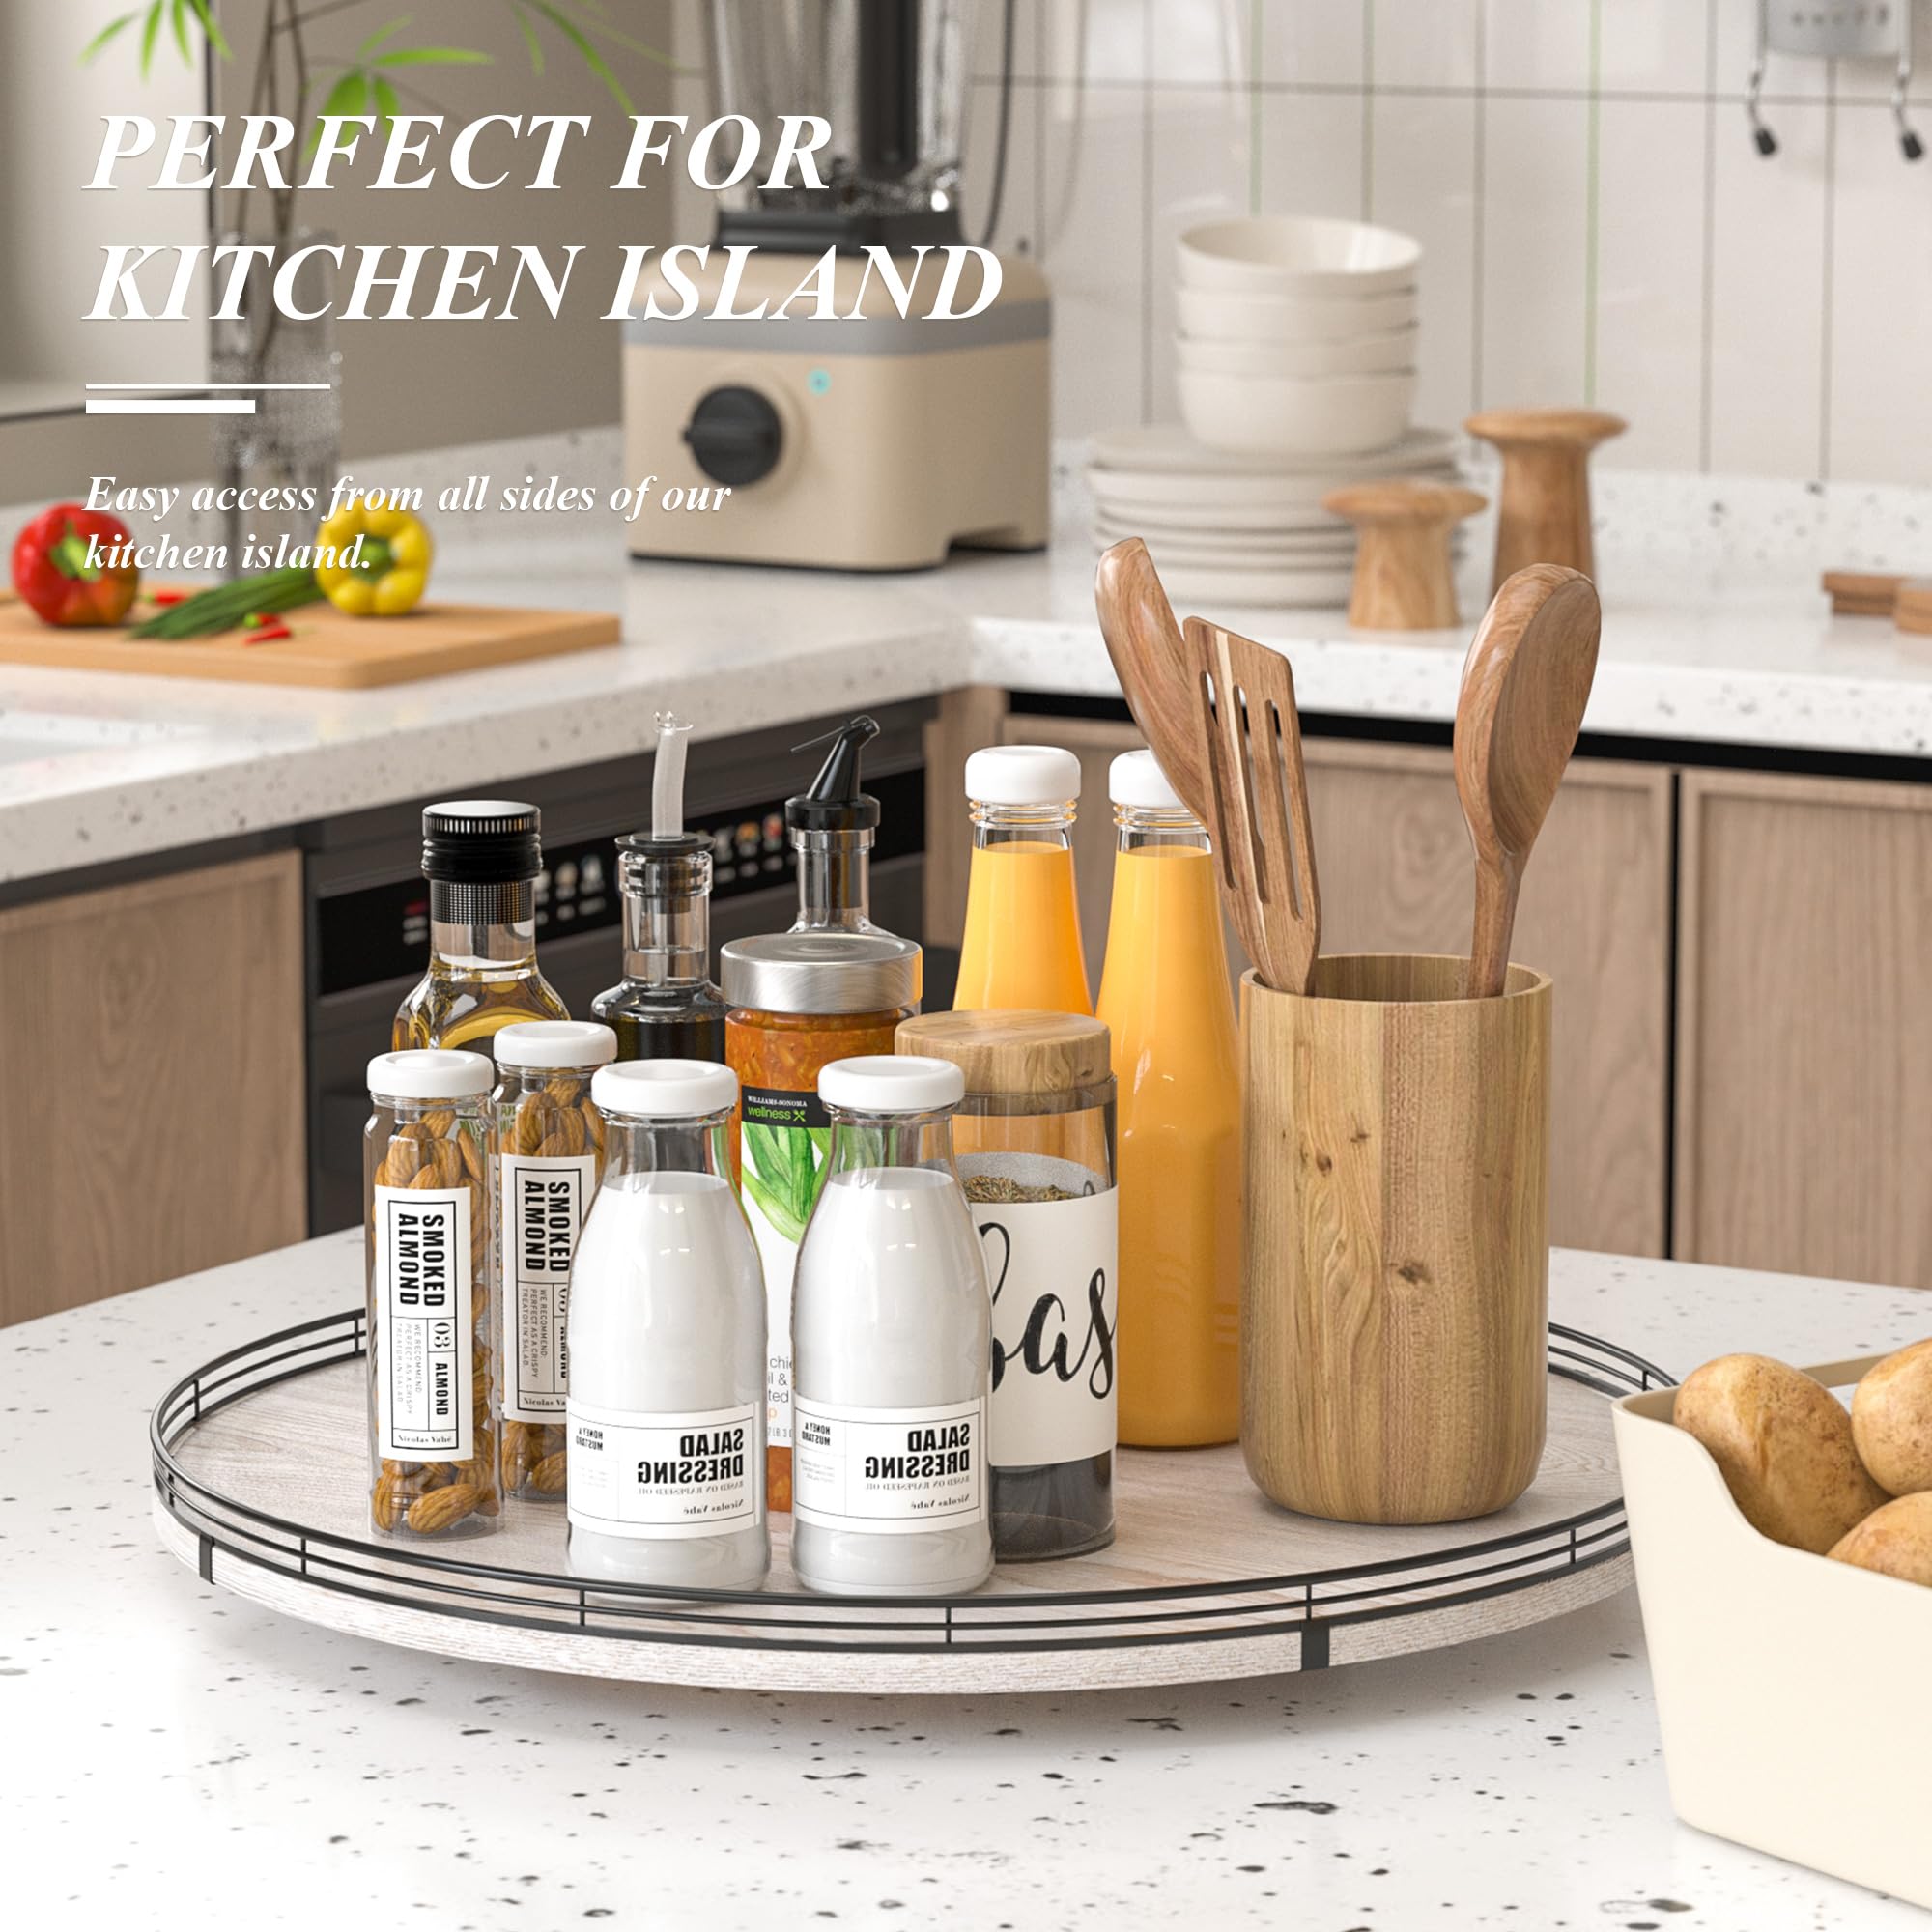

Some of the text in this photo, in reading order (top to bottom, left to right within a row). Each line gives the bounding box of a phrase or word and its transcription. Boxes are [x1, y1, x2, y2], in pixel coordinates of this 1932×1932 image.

[747, 1095, 807, 1107] WILLIAMS-SONOMA
[748, 1106, 791, 1120] wellness
[525, 1180, 546, 1271] ALMOND
[548, 1181, 570, 1272] SMOKED
[398, 1213, 419, 1305] ALMOND
[422, 1214, 445, 1307] SMOKED
[540, 1289, 548, 1301] WE
[433, 1322, 451, 1349] 03
[531, 1327, 538, 1339] AS
[435, 1362, 449, 1415] ALMOND
[779, 1373, 788, 1386] &
[523, 1397, 554, 1406] Nicolas
